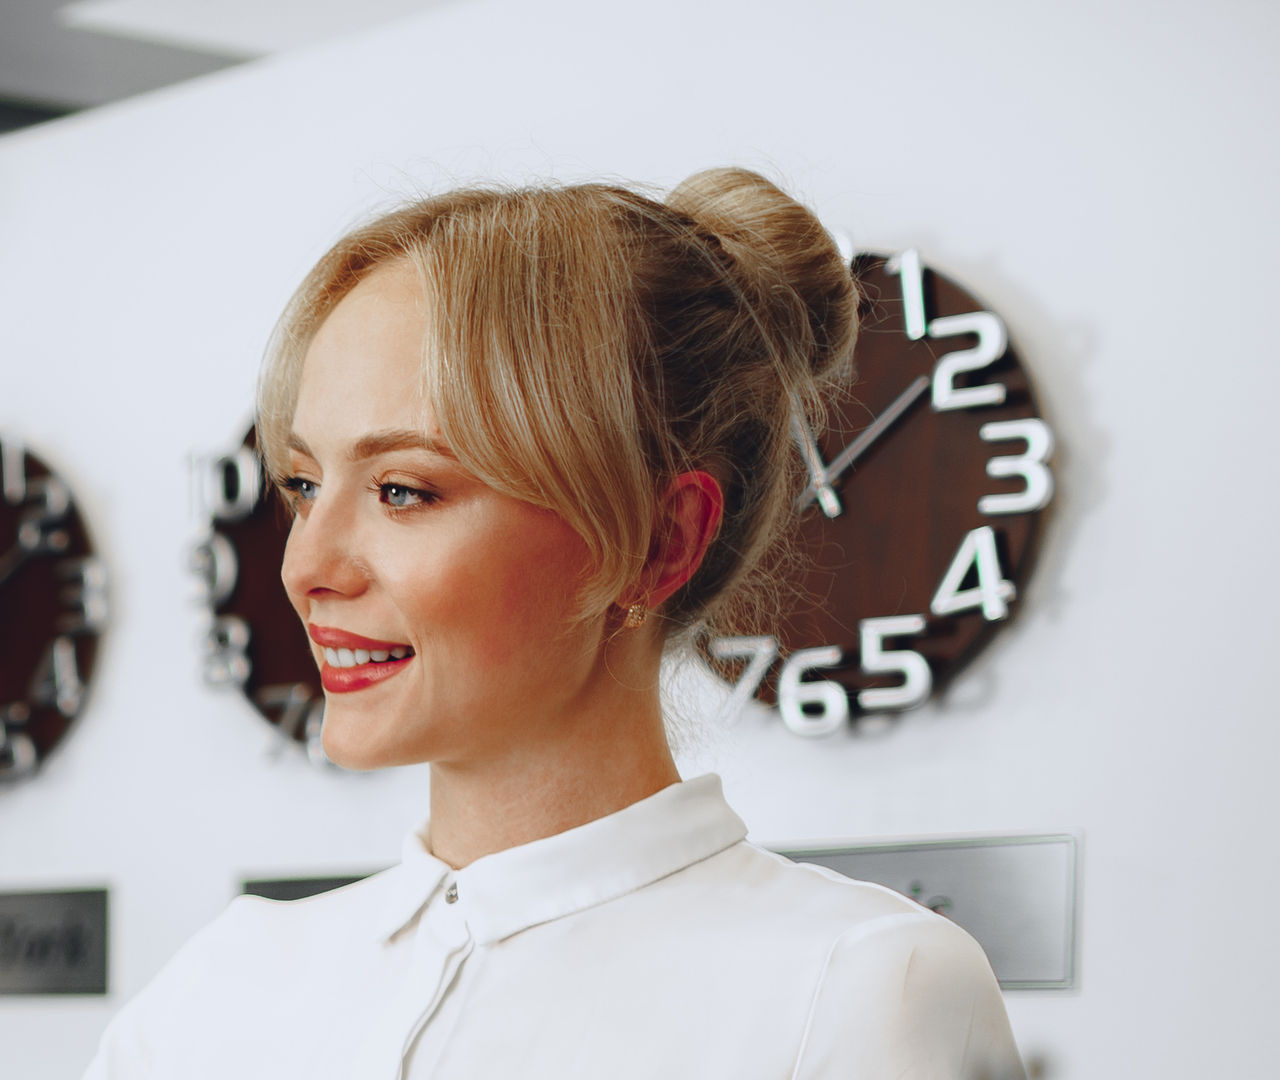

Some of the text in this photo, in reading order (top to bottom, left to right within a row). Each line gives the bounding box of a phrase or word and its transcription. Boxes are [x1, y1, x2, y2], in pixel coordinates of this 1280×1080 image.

[885, 248, 927, 340] 1
[927, 309, 1008, 412] 2
[977, 417, 1056, 515] 3
[929, 524, 1017, 622] 4
[708, 634, 778, 720] 7
[776, 644, 850, 738] 6
[856, 612, 934, 710] 5
